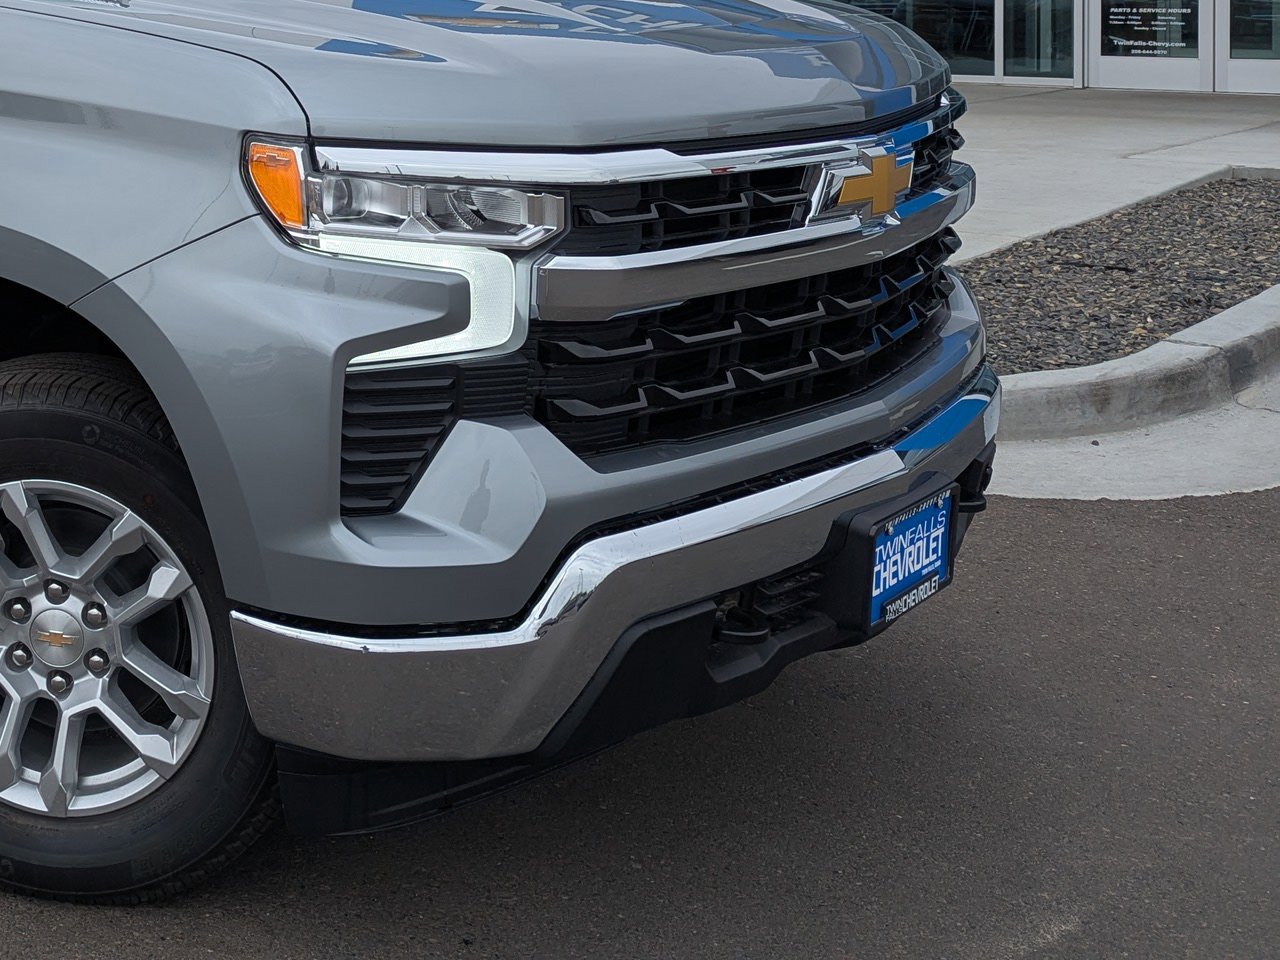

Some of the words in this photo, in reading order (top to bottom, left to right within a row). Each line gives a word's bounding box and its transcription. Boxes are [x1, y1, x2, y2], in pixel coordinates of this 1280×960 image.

[872, 527, 945, 597] CHEVROLET
[875, 510, 946, 564] TWINFALLS
[886, 599, 903, 615] TWIN
[902, 574, 940, 613] CHEVROLET
